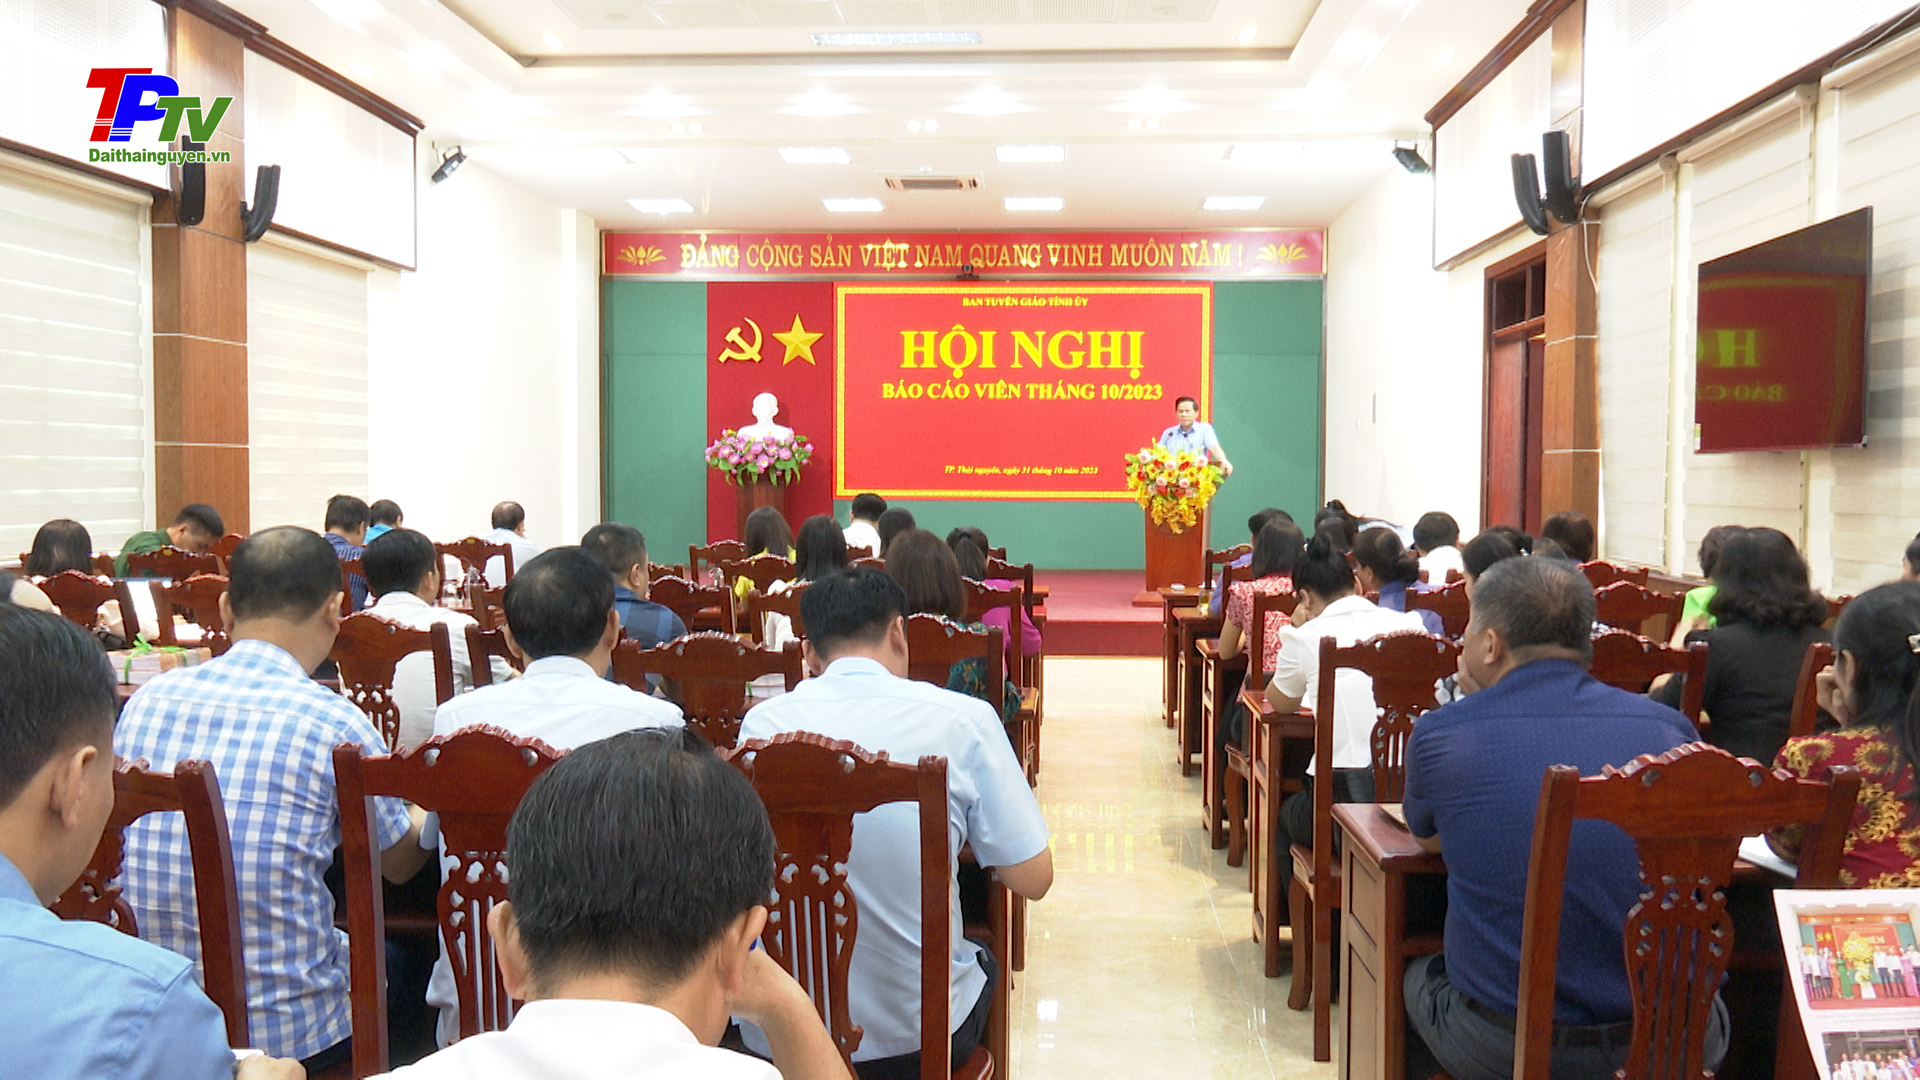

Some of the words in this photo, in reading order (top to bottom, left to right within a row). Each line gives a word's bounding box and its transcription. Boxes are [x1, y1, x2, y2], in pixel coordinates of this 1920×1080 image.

[680, 234, 740, 268] ĐẢNG
[746, 237, 804, 271] CỘNG
[810, 234, 853, 268] SẢN
[858, 238, 910, 271] VIỆT
[914, 243, 963, 268] NAM
[968, 243, 1043, 269] QUANG
[1047, 243, 1104, 268] VINH
[1110, 237, 1175, 268] MUÔN
[1180, 238, 1232, 268] NĂM
[962, 297, 984, 306] BAN
[984, 295, 1019, 306] TUYÊN
[1020, 295, 1047, 306] GIÁO
[899, 323, 998, 379] HỘI
[1010, 330, 1145, 380] NGHỊ
[882, 379, 923, 400] BÁO
[927, 379, 970, 400] CÁO
[974, 379, 1021, 400] VIÊN
[1025, 379, 1095, 400] THÁNG
[1100, 383, 1163, 400] 10/2023
[1031, 465, 1052, 476] tháng
